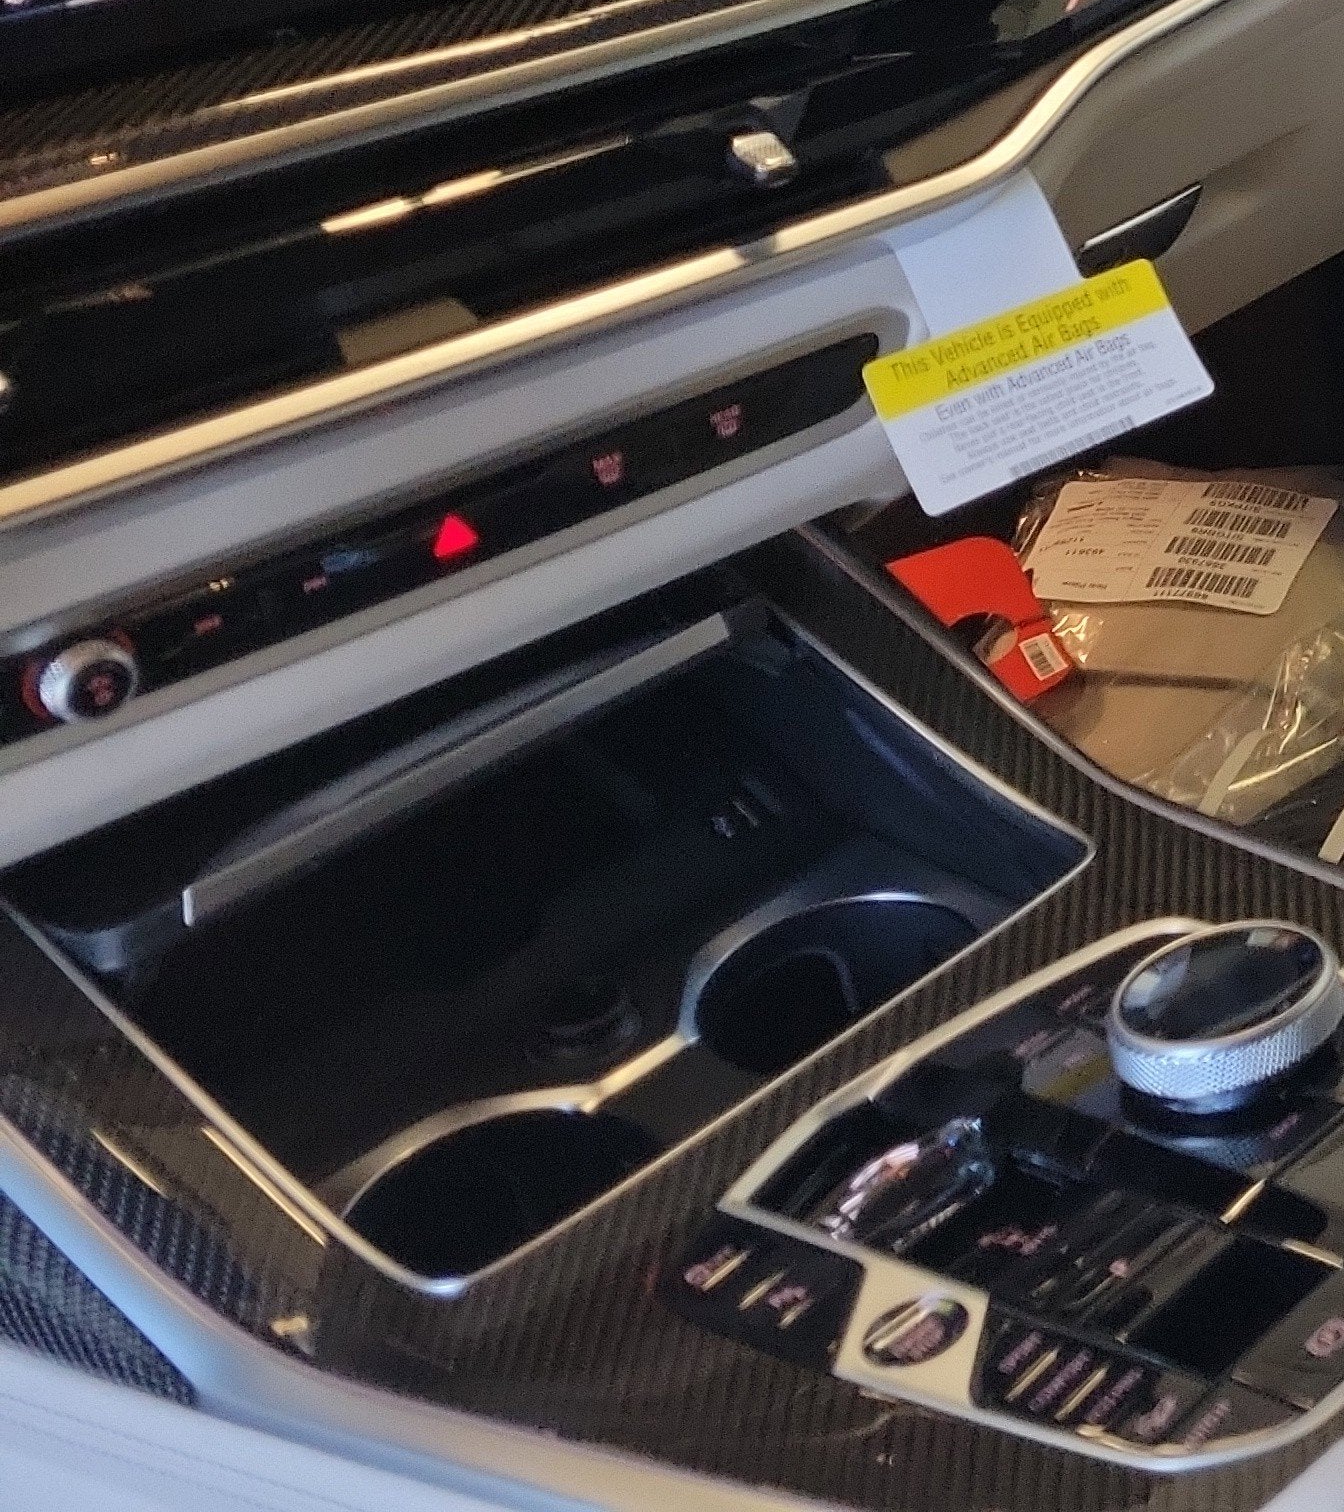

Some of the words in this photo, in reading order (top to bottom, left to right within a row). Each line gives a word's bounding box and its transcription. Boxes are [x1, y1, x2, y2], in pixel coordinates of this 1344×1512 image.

[891, 356, 929, 382] This
[930, 334, 992, 367] Vehicle
[1015, 292, 1093, 339] Equipped
[1096, 275, 1130, 302] with
[946, 343, 1029, 389] Advanced
[1031, 334, 1058, 360] Air
[1061, 315, 1102, 344] Bags
[935, 397, 971, 423] Even
[1007, 355, 1073, 391] Advanced
[1075, 347, 1095, 370] Air
[1095, 332, 1130, 357] Bags
